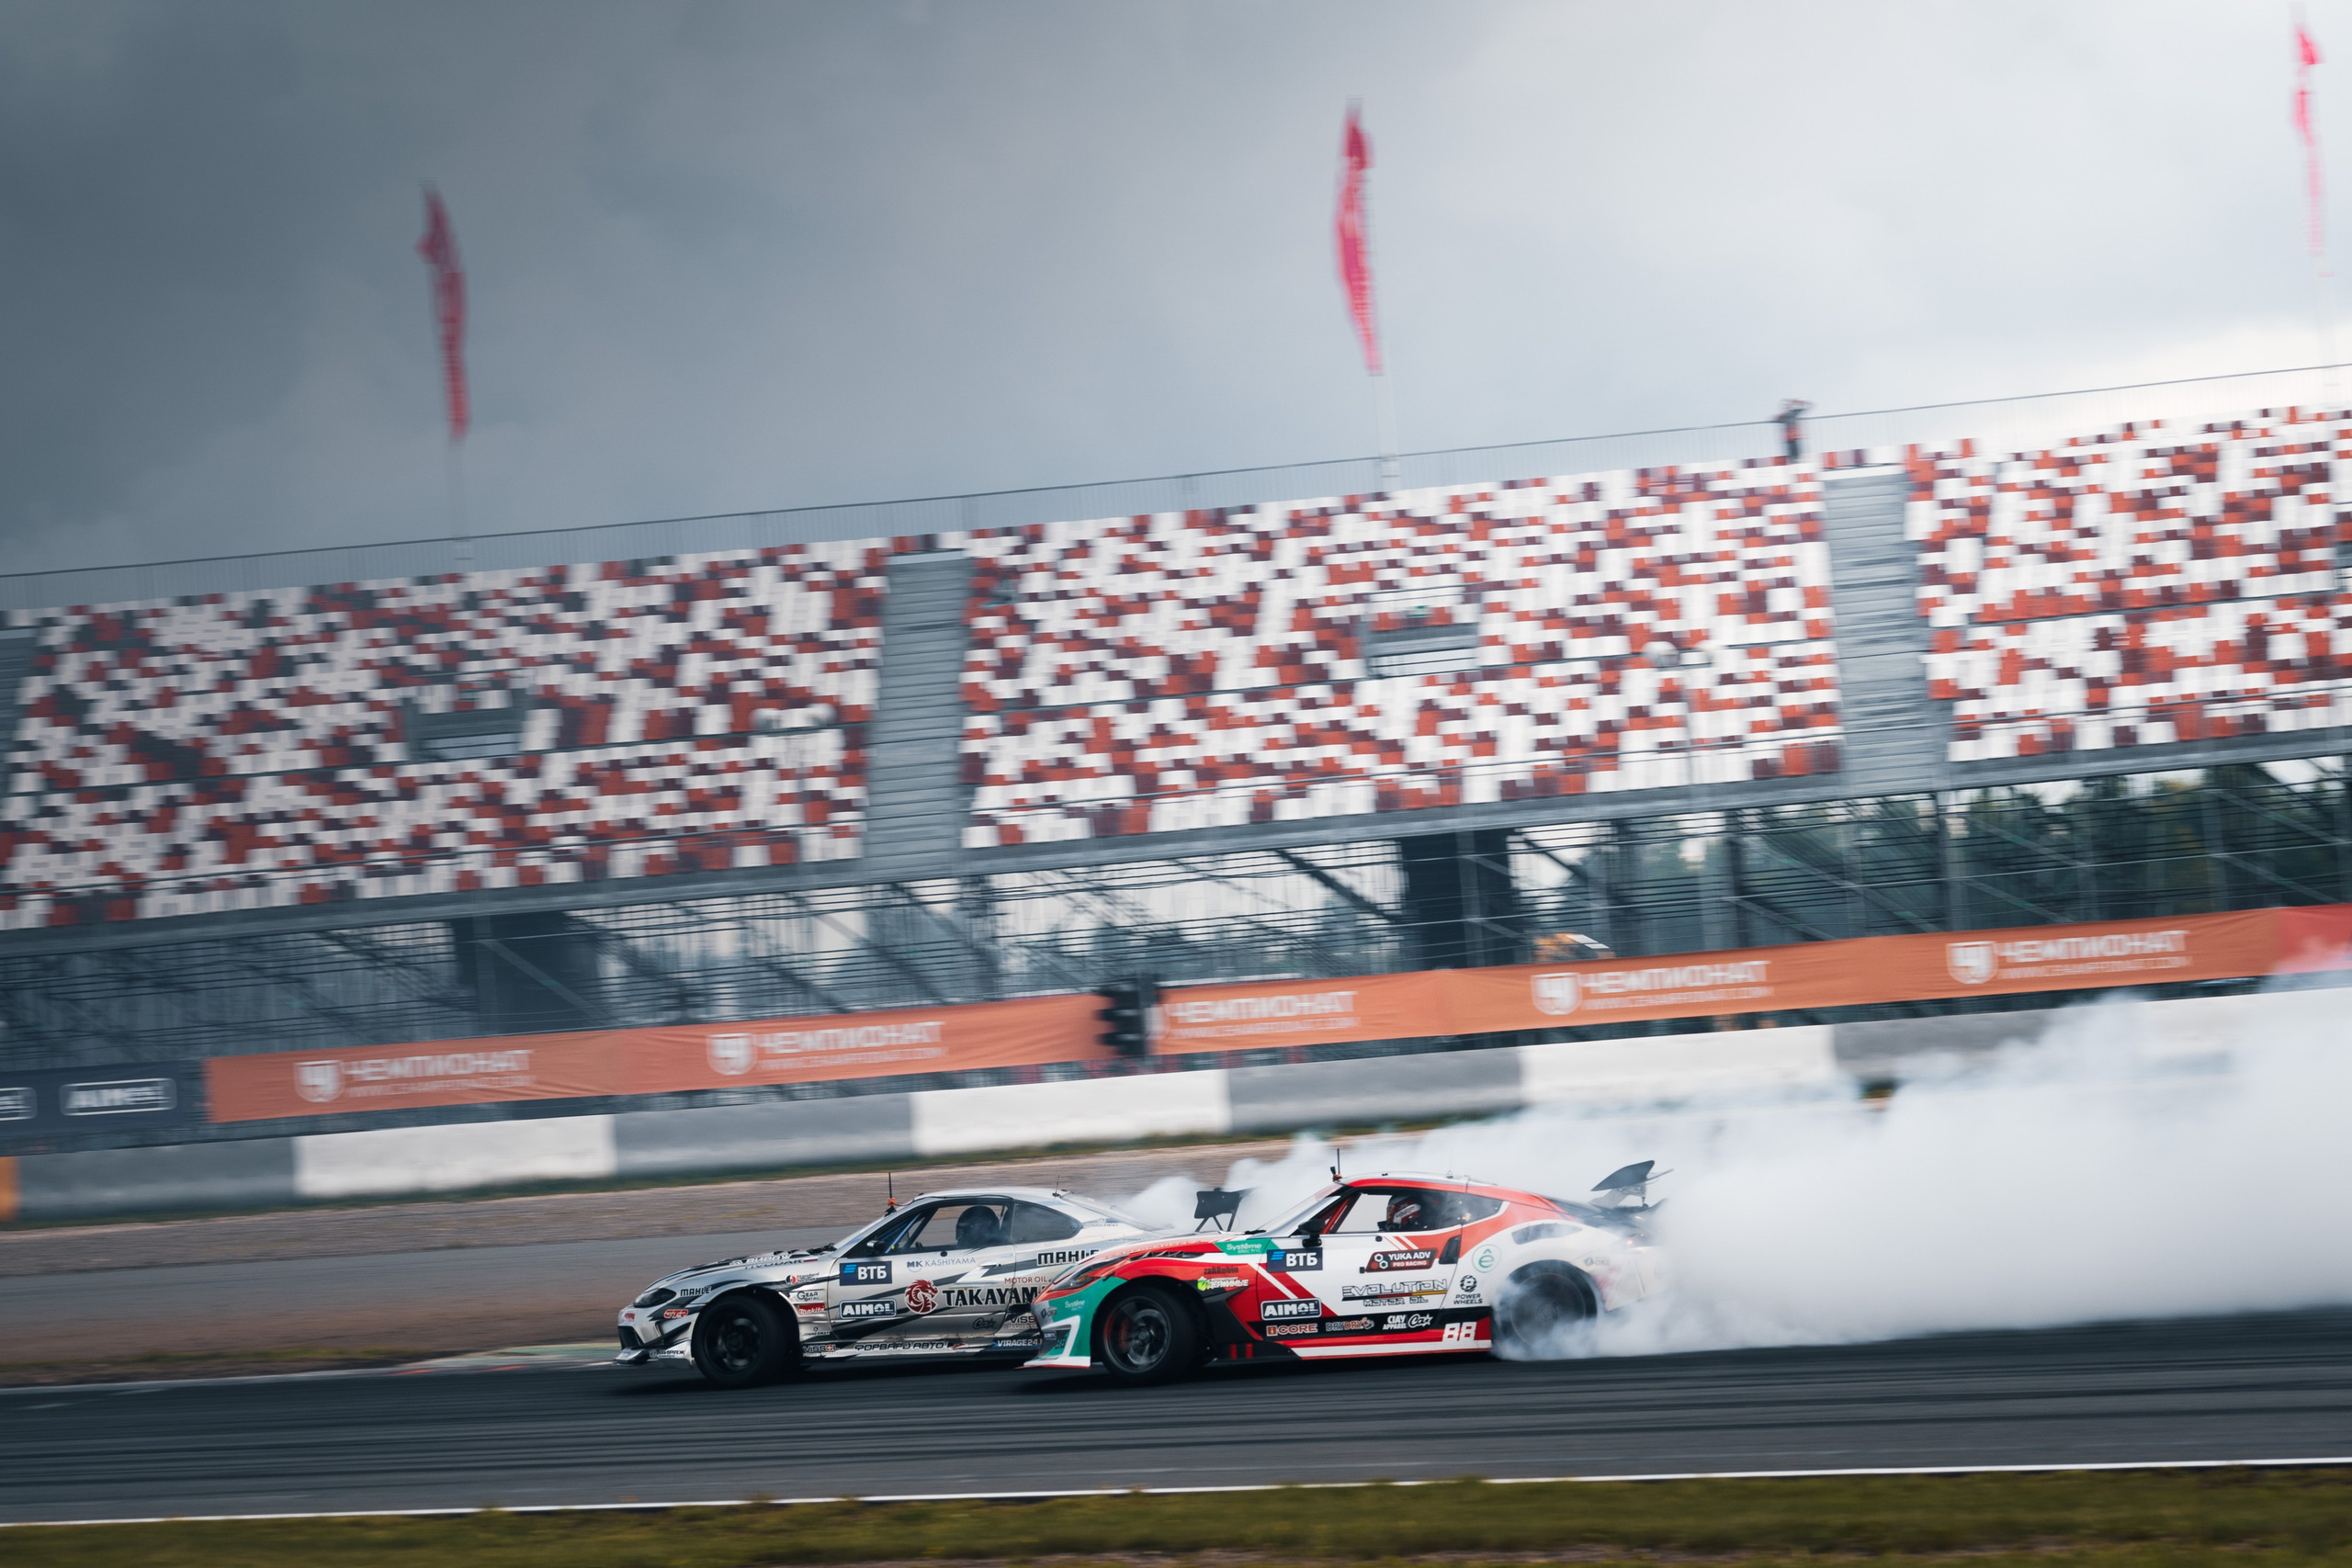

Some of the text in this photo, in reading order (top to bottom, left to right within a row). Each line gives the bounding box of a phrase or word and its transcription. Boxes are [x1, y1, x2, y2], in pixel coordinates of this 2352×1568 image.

[1995, 931, 2189, 962] ЧЕМПИОНАТ
[1578, 961, 1770, 993] ЧЕМПИОНАТ
[755, 1021, 945, 1053] ЧЕМПИОНАТ
[345, 1050, 533, 1080] ЧЕМПИОНАТ
[906, 1258, 976, 1268] MK KASHIYAMA
[1285, 1252, 1317, 1267] ВТБ
[1388, 1251, 1431, 1261] YUKA ADV
[857, 1265, 887, 1280] ВТБ
[680, 1286, 711, 1297] MAHLE
[1342, 1279, 1448, 1296] EVOLUTION
[942, 1286, 1046, 1307] TAKAYAM
[1363, 1296, 1429, 1307] MOTOR OIL
[842, 1303, 894, 1315] AIMOL
[1264, 1303, 1318, 1316] AIMOL
[1010, 1315, 1036, 1324] VISS
[1442, 1322, 1477, 1342] 88
[854, 1341, 944, 1351] ФОРВАРД АВТО
